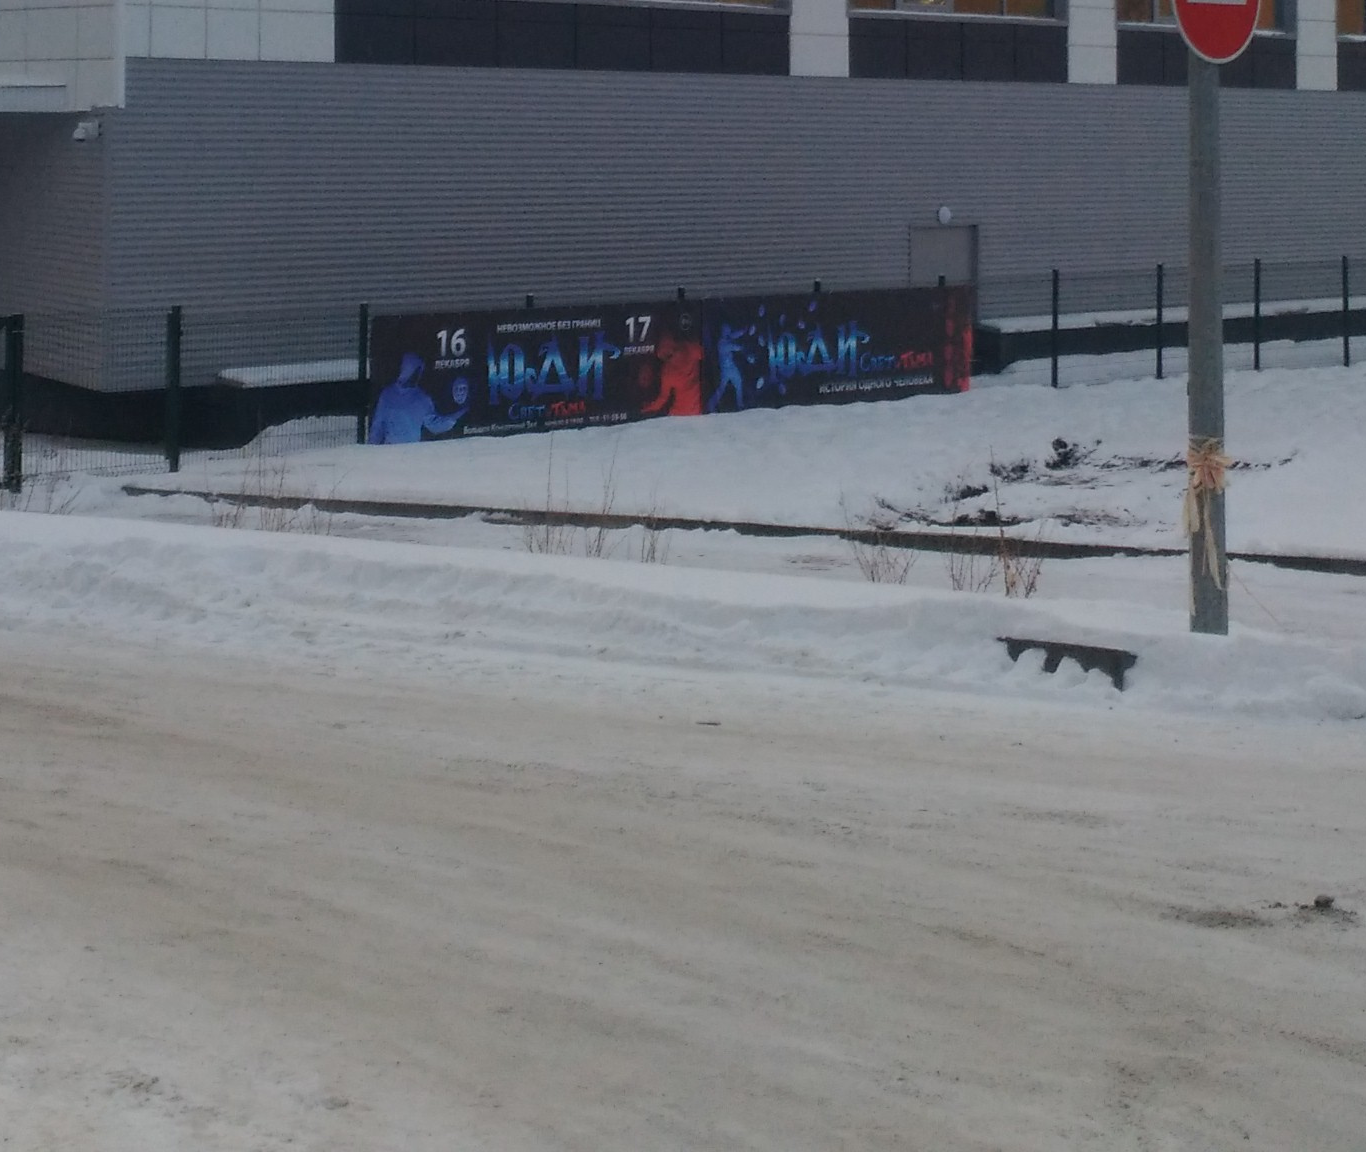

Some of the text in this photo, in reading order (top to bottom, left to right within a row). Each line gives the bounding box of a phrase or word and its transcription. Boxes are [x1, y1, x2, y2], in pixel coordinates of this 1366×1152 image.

[496, 320, 557, 334] НЕВОЗМОЖНОЕ
[557, 319, 571, 331] БЕЗ
[625, 315, 652, 343] 17
[435, 328, 467, 358] 16
[623, 344, 656, 356] ДЕКАБРЯ
[434, 358, 471, 370] ДЕКАБРЯ
[819, 374, 934, 394] ИСТОРИЯ ОДНОГО ЧЕЛОВЕКА
